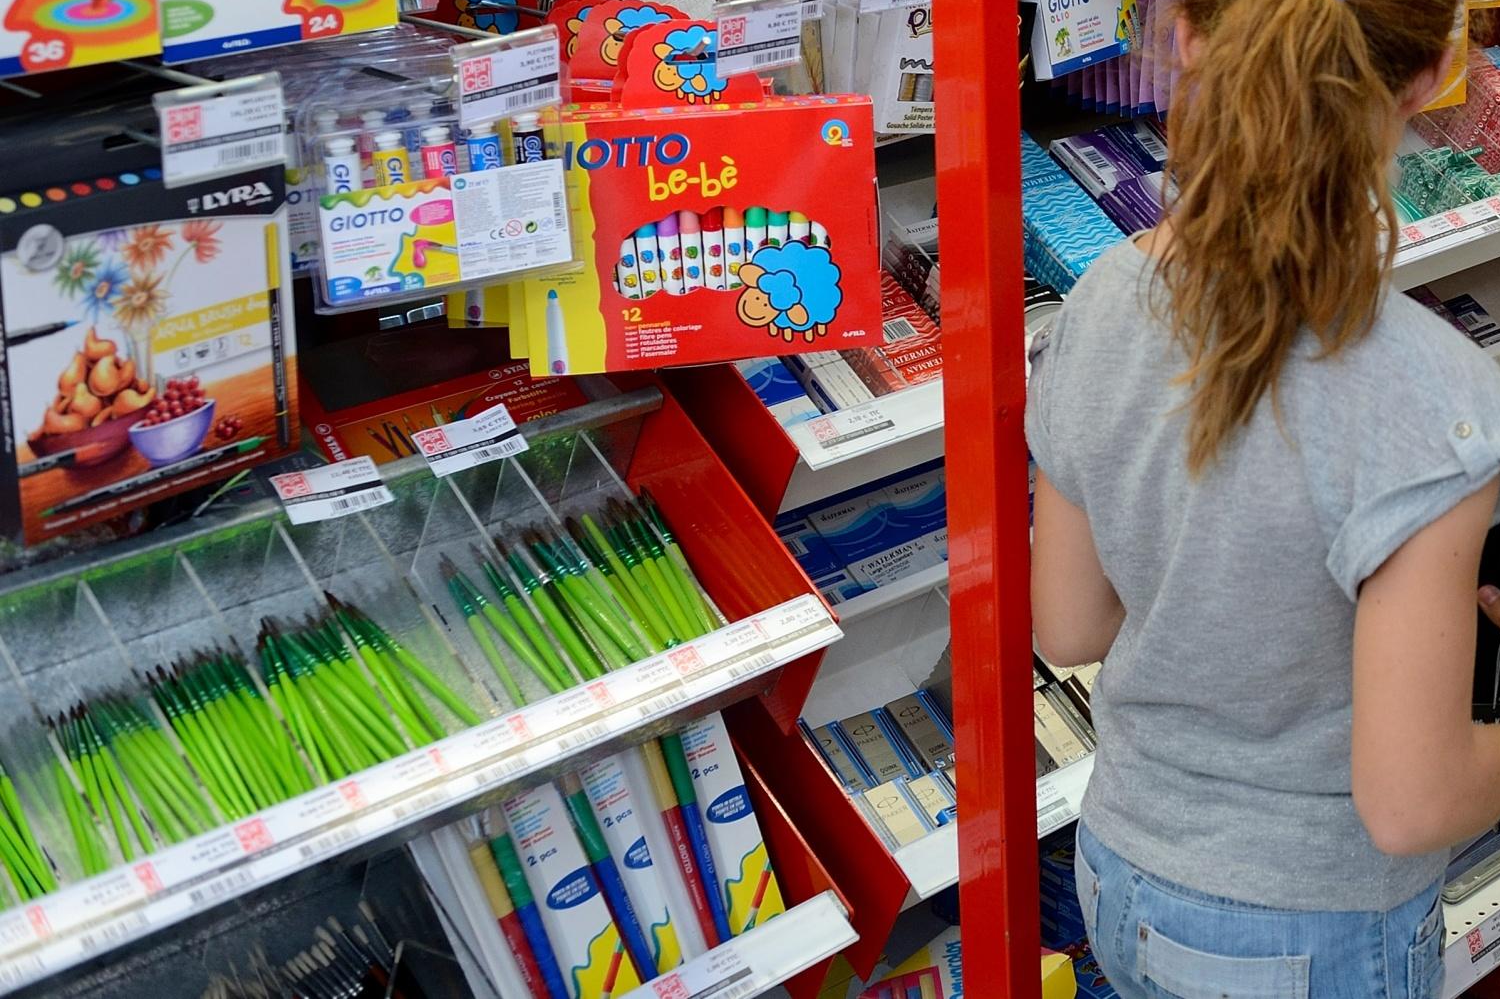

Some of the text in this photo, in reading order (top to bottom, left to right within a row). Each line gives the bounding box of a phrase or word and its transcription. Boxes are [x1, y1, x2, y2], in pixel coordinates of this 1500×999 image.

[308, 13, 338, 32] 24
[1050, 11, 1069, 23] OLIO
[28, 40, 65, 63] 36
[648, 155, 738, 201] be-bè
[203, 182, 273, 211] LYRA
[330, 208, 404, 232] GIOTTO
[621, 308, 642, 322] 12
[485, 377, 560, 402] Crayons de couleur
[508, 389, 548, 403] Farbstifte
[868, 545, 912, 569] WATERMAN
[857, 734, 884, 746] PARKER
[929, 743, 944, 753] QUINK
[691, 764, 719, 779] 2 pcs
[880, 764, 897, 773] QUINK
[603, 809, 632, 828] 2 pcs
[527, 846, 557, 867] 2 pcs
